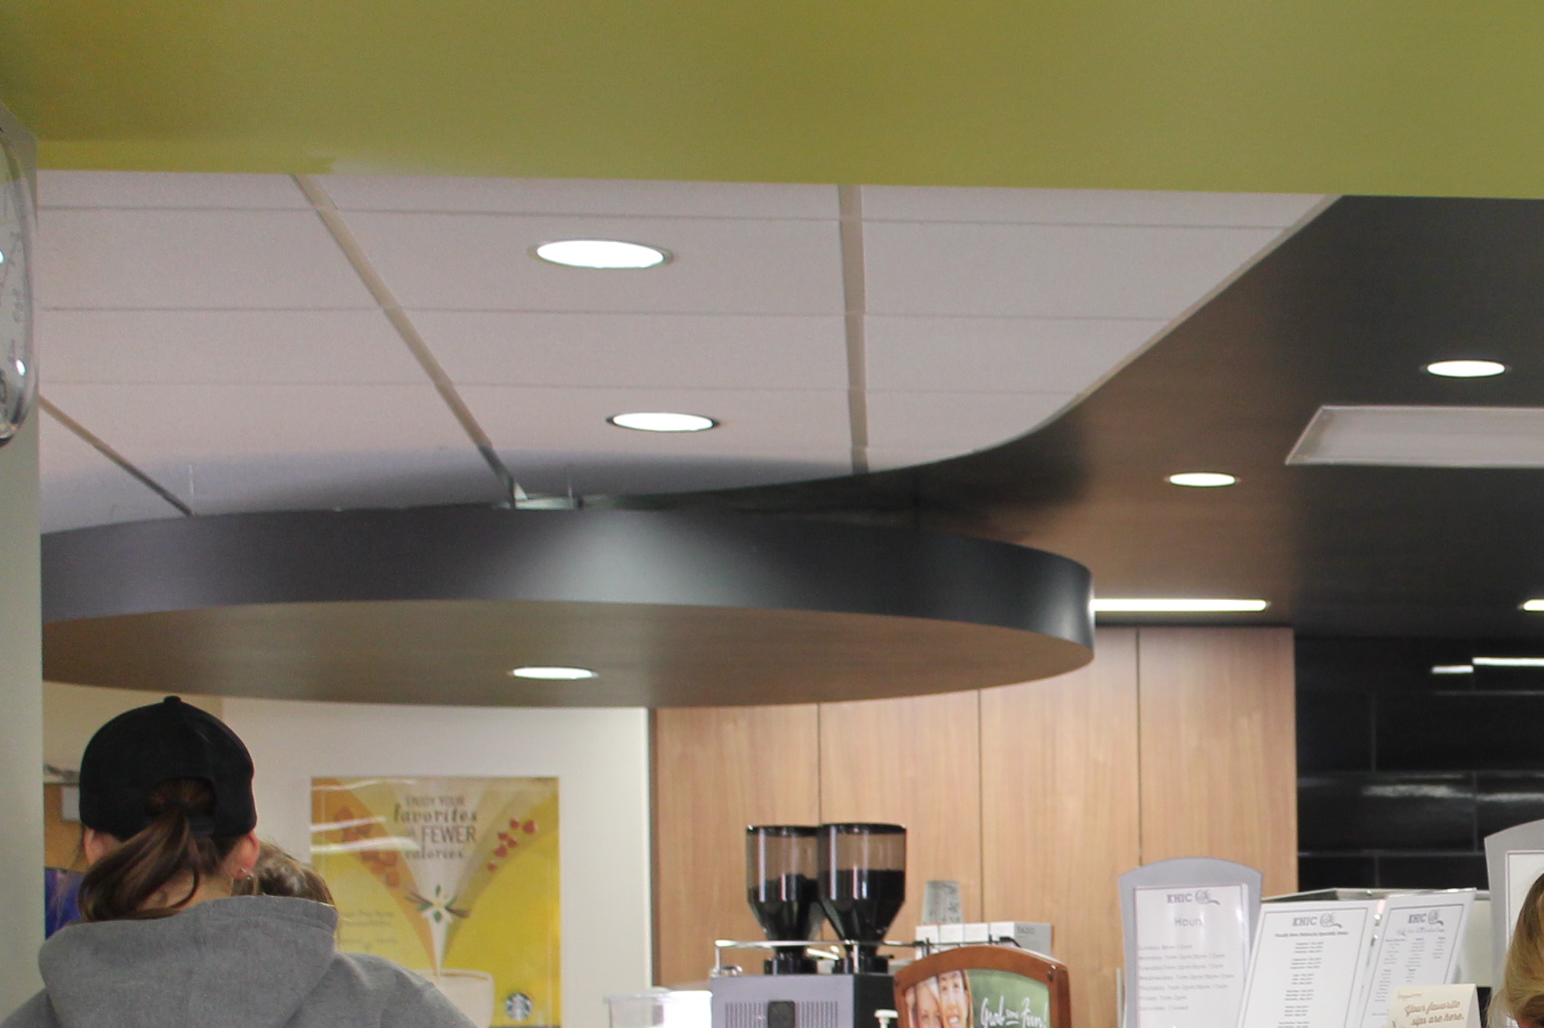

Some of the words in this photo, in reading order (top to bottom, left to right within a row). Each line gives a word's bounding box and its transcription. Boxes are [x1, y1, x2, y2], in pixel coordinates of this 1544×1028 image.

[394, 802, 477, 822] favorites
[421, 825, 476, 843] FEWER
[405, 845, 464, 859] calories
